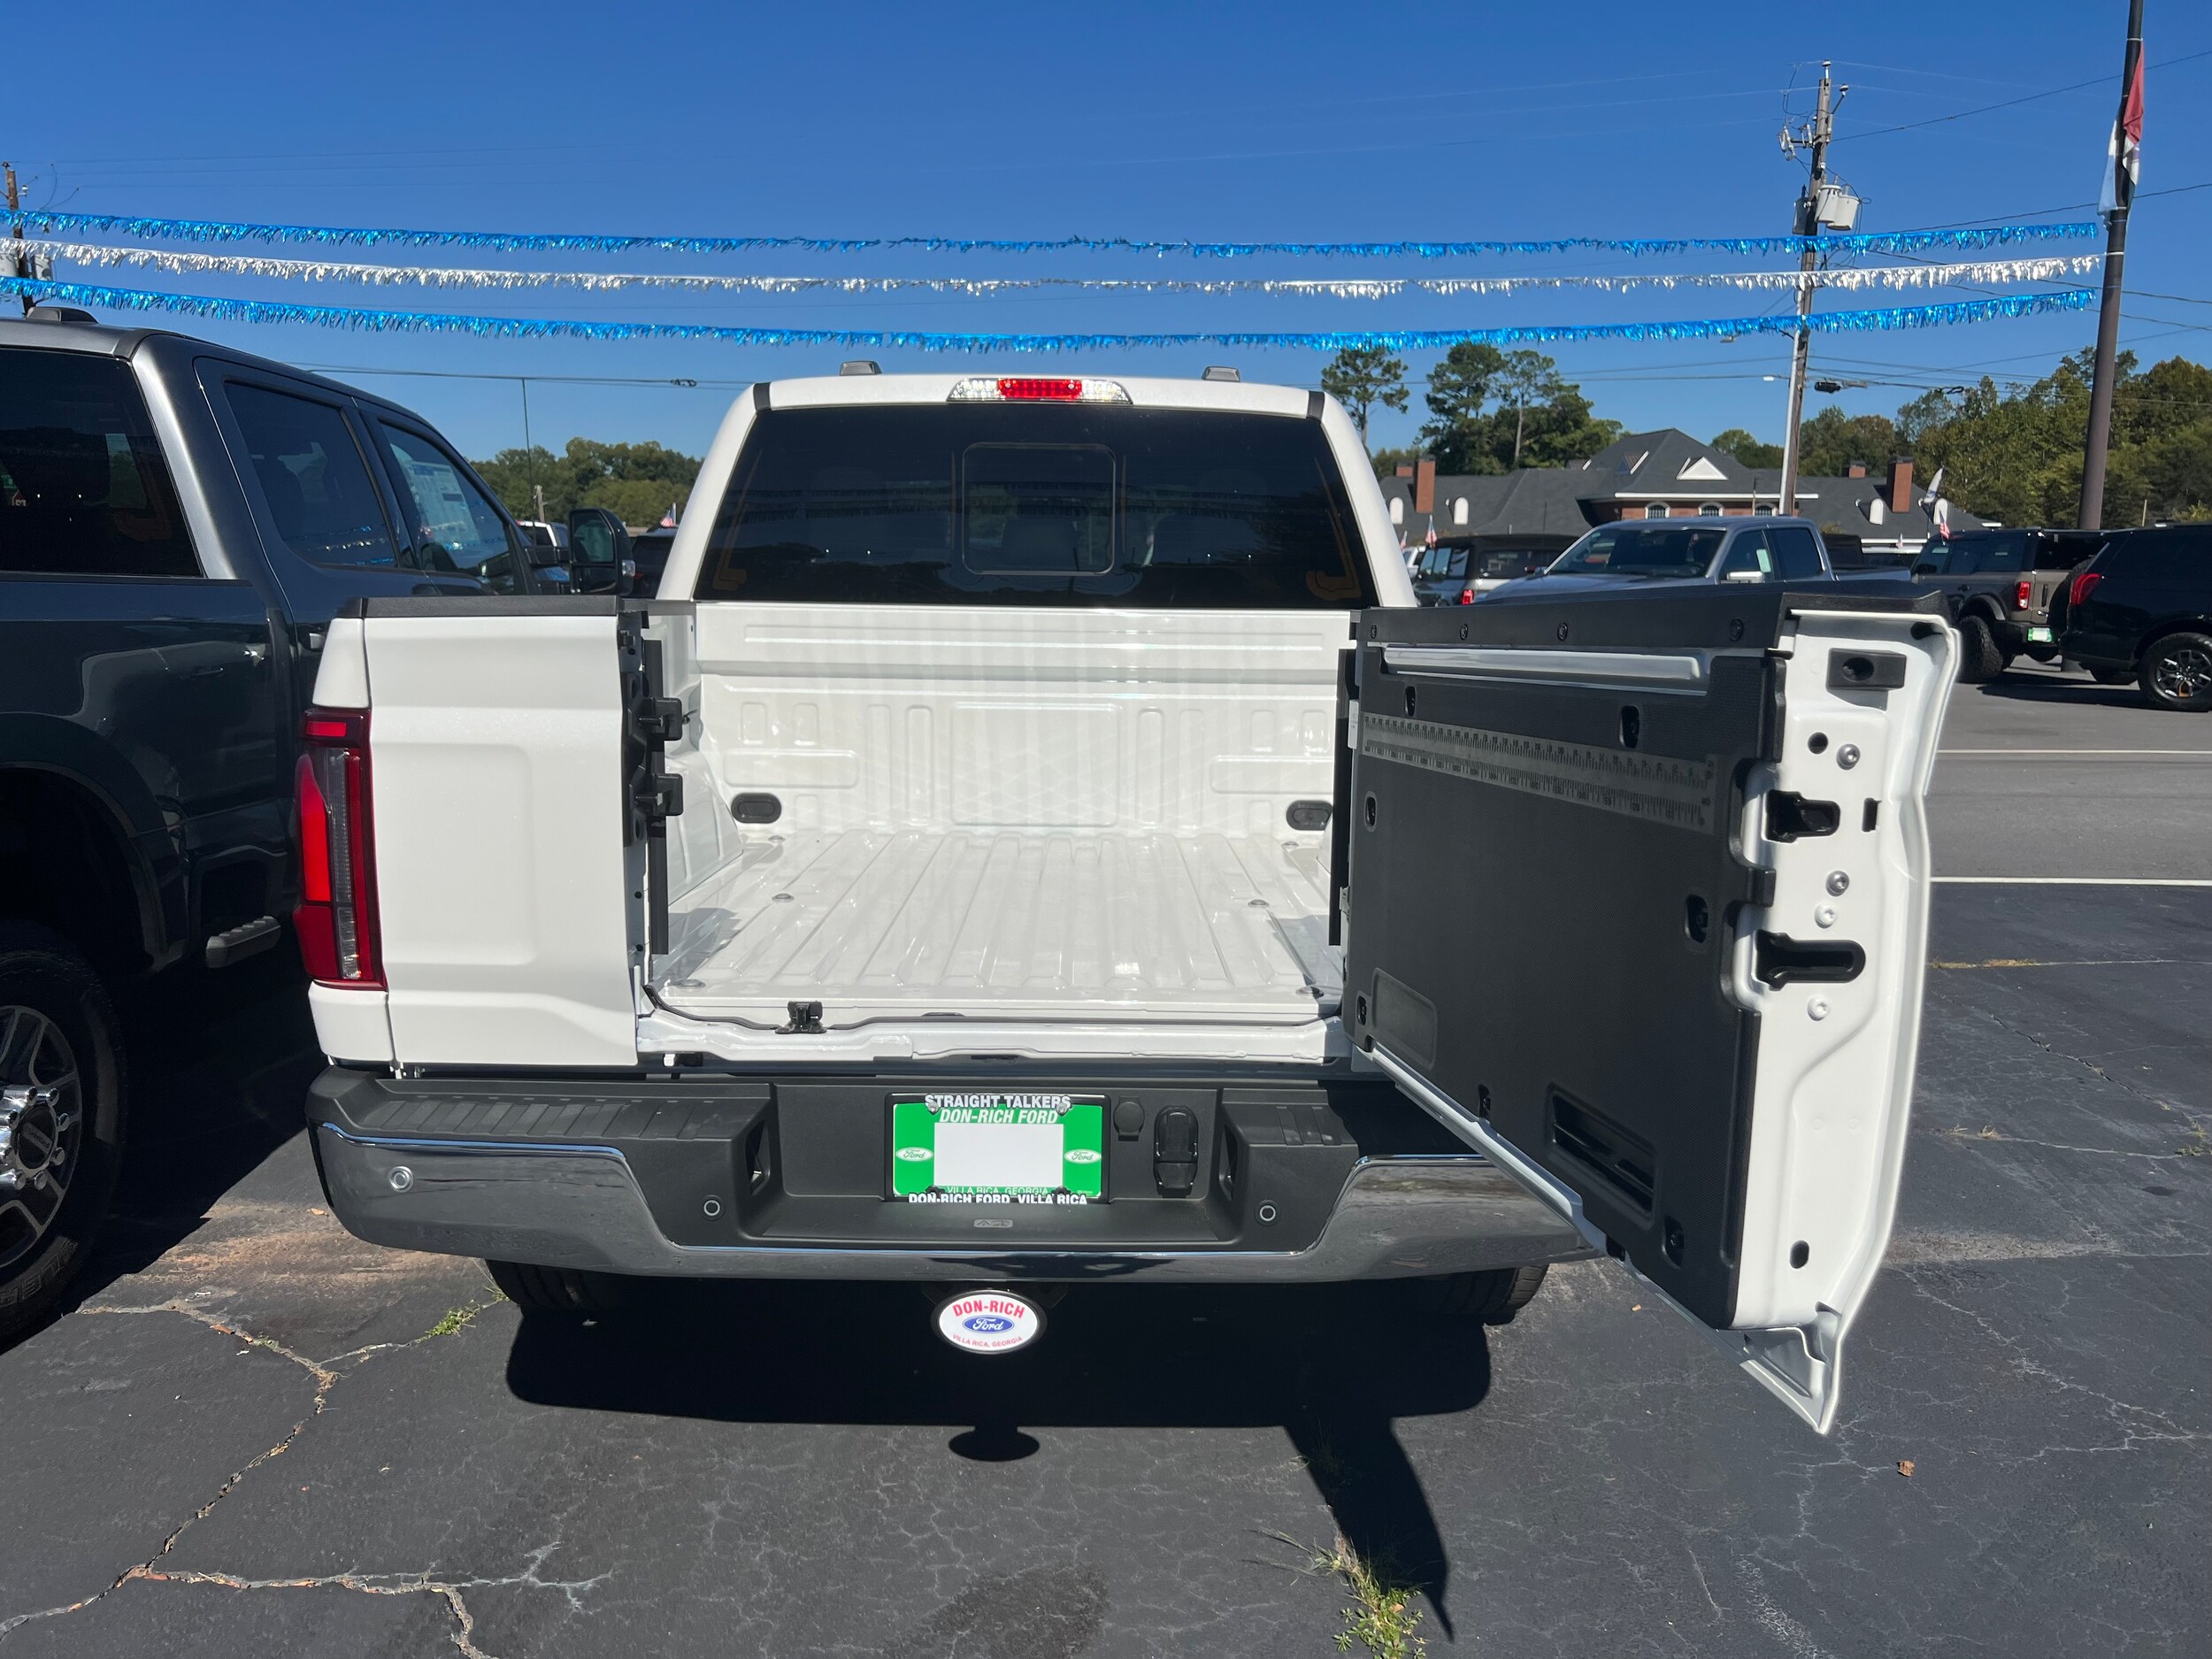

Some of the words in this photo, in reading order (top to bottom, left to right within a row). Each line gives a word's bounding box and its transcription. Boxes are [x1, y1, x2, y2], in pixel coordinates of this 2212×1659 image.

[925, 1094, 1000, 1108] STRAIGHT
[1004, 1094, 1071, 1109] TALKERS
[940, 1109, 1015, 1123] DON-RICH
[1017, 1110, 1058, 1124] FORD
[902, 1148, 926, 1158] Ford
[1071, 1150, 1094, 1161] Ford
[1018, 1194, 1053, 1204] VILLA
[1056, 1194, 1087, 1204] RICA
[952, 1300, 1025, 1318] DON-RICH
[972, 1317, 1003, 1331] Ford
[953, 1333, 971, 1345] VILLA
[992, 1336, 1023, 1348] GEORGIA
